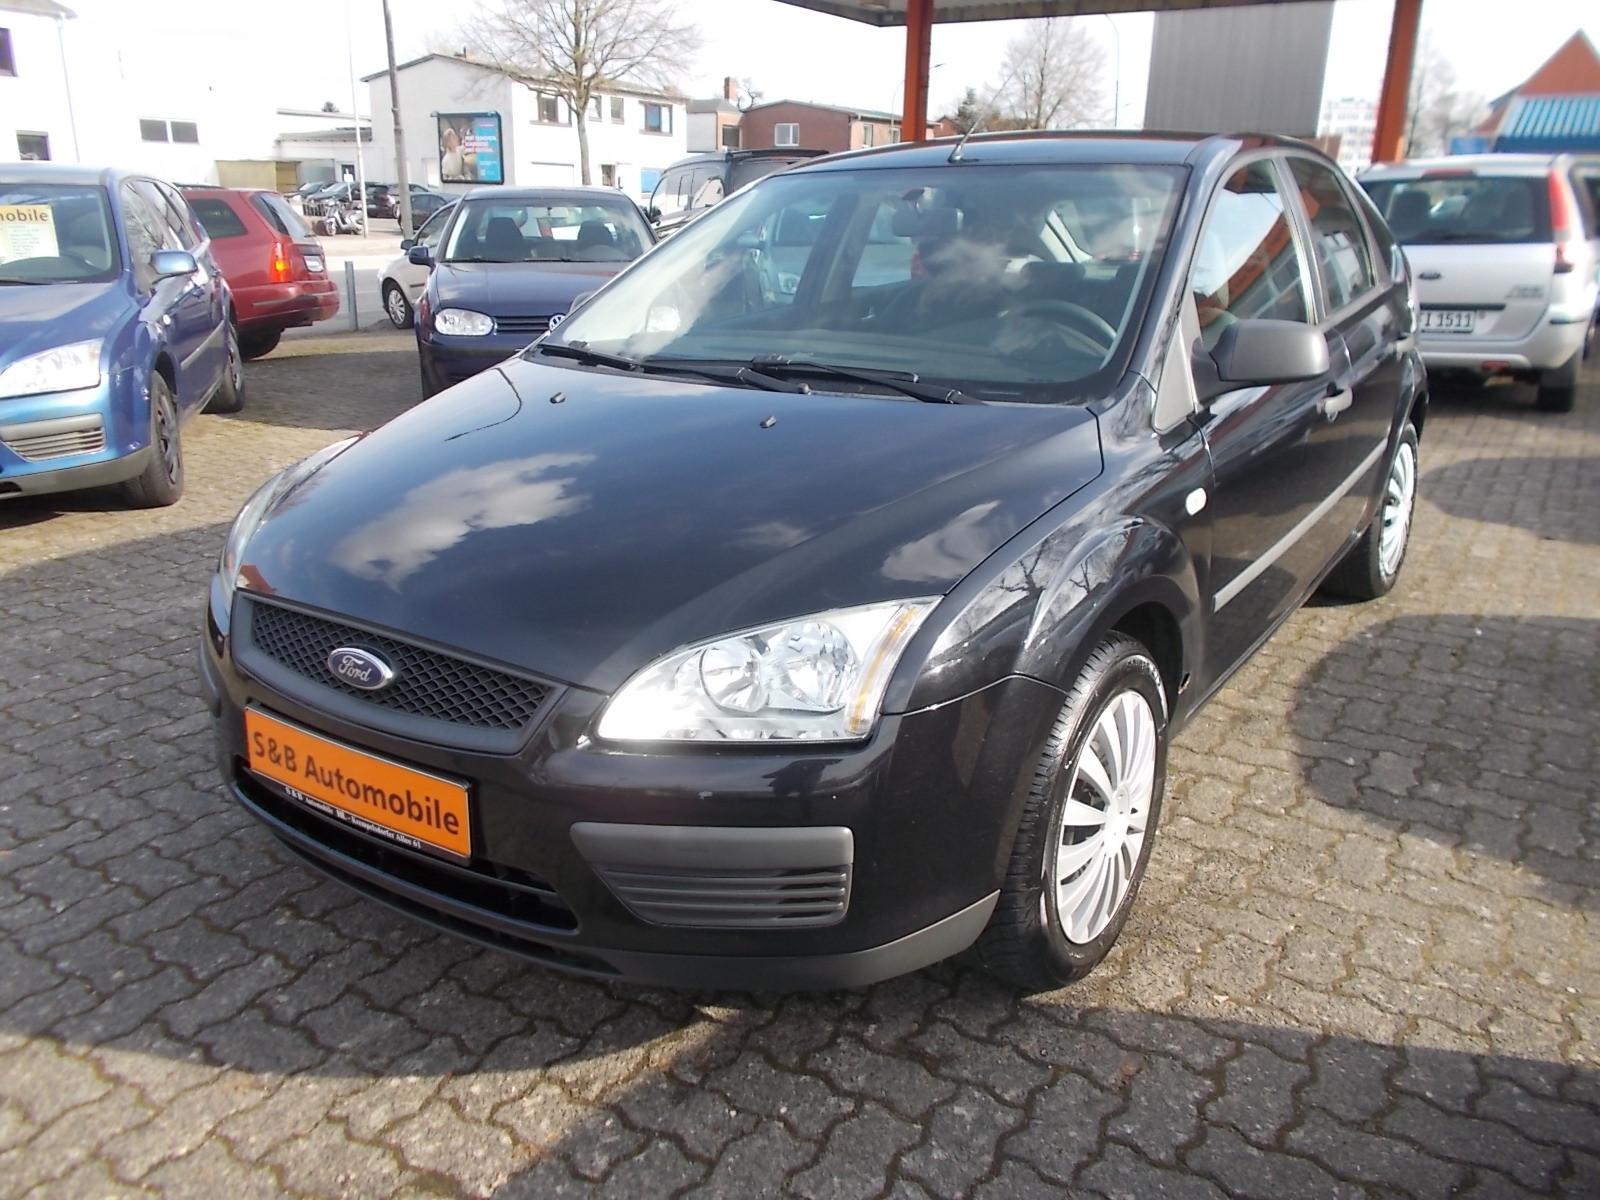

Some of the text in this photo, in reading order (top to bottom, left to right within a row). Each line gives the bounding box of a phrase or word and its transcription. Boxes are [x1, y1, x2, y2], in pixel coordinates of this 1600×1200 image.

[339, 655, 372, 682] Ford
[253, 730, 460, 836] S&B Automobile
